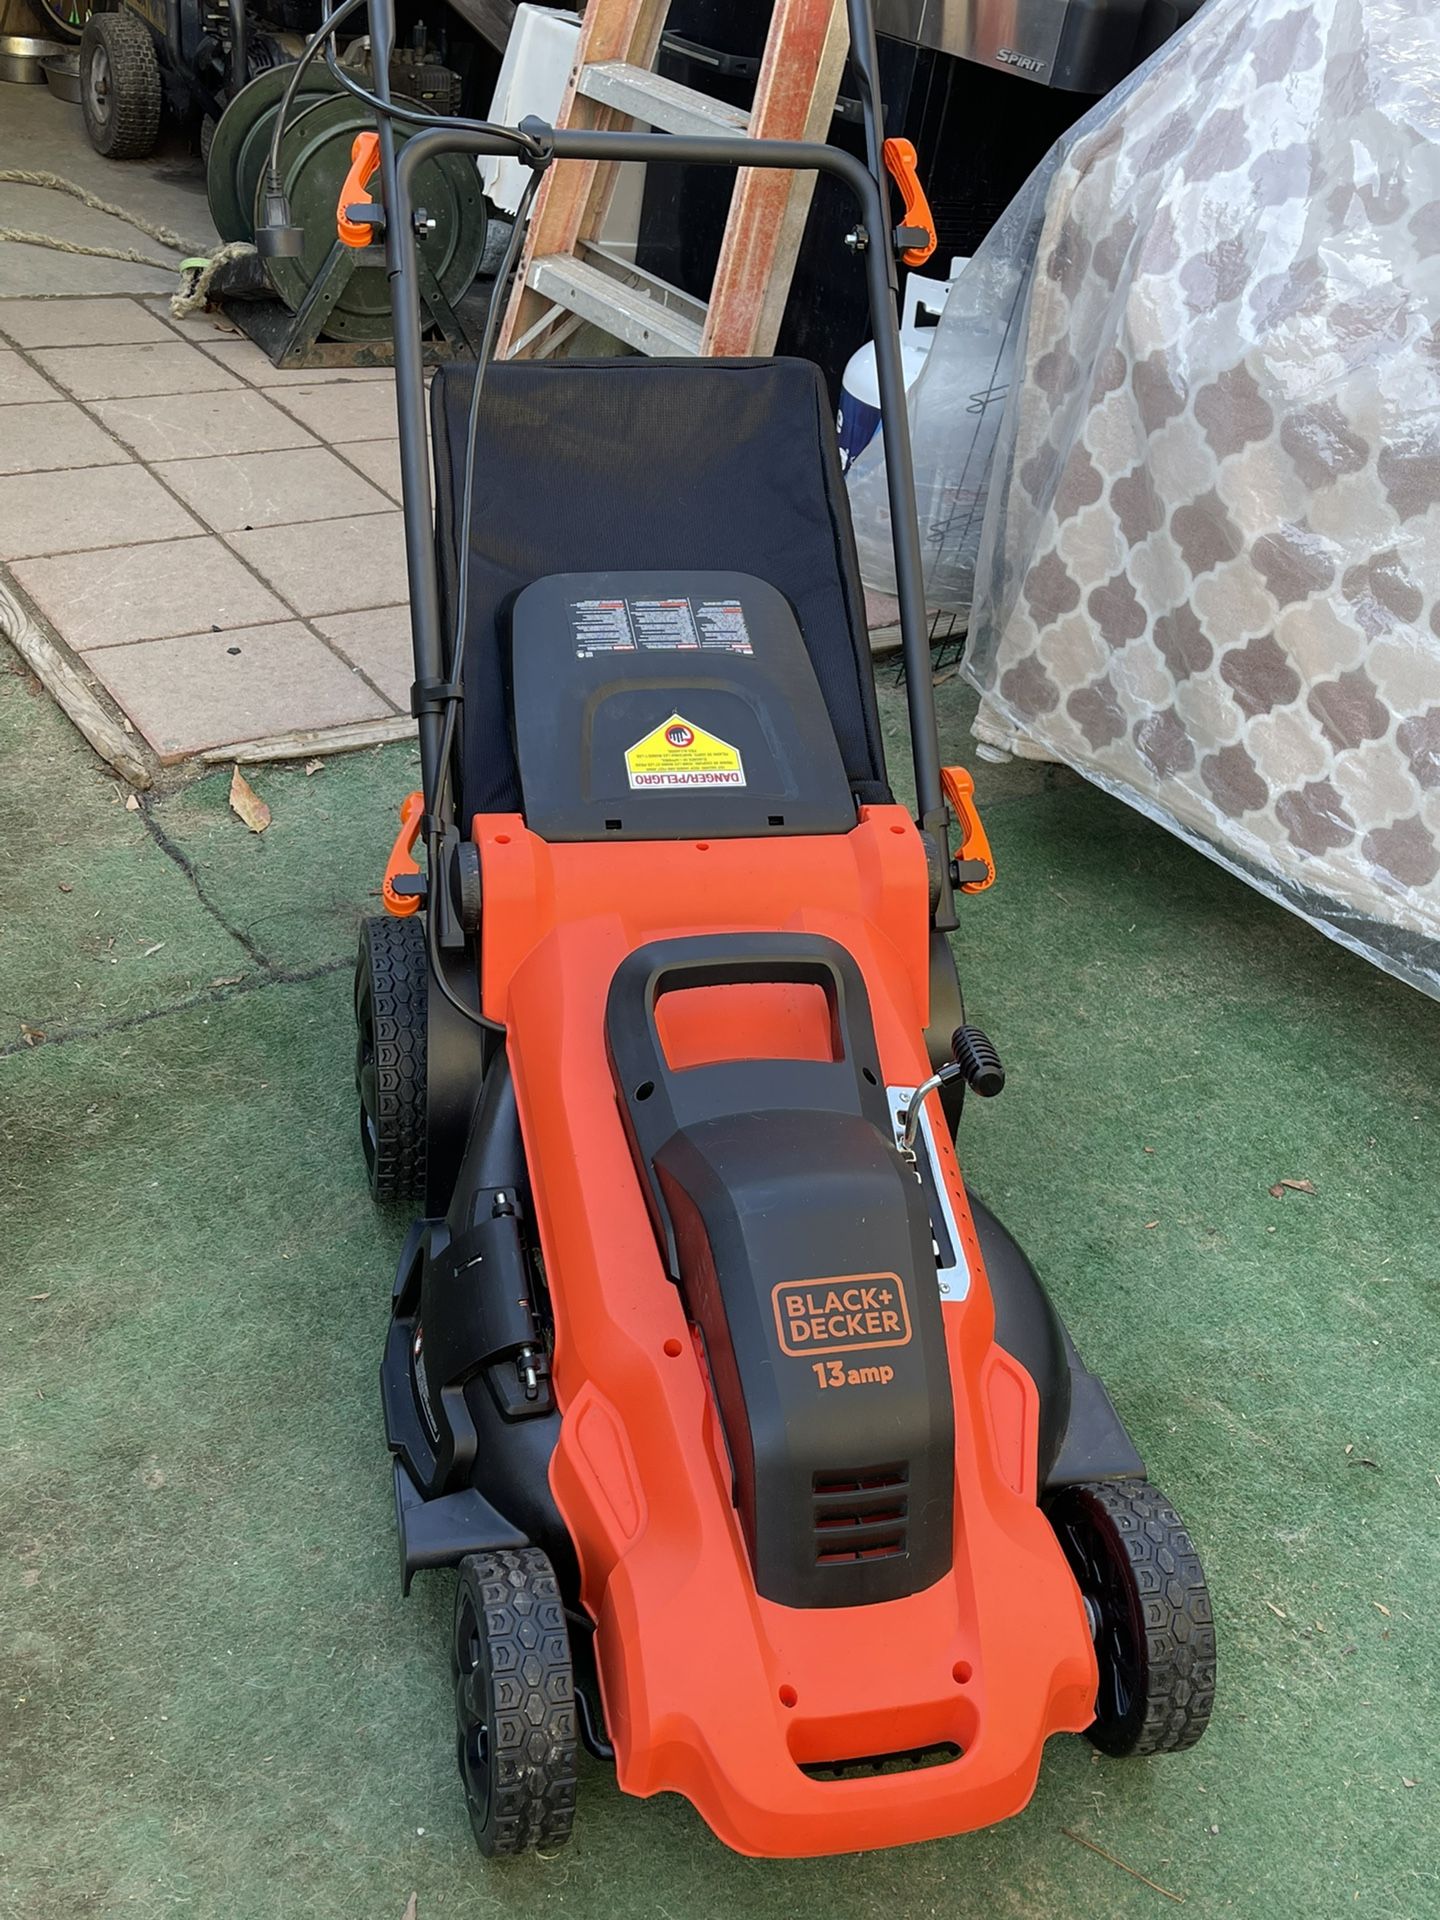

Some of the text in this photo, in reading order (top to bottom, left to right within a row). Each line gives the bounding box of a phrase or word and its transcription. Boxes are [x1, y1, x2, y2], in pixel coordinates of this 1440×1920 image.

[996, 48, 1045, 72] SPIRIT
[635, 773, 739, 785] DANGER/PELIGRO
[785, 1288, 893, 1317] BLACK+
[790, 1311, 900, 1342] DECKER
